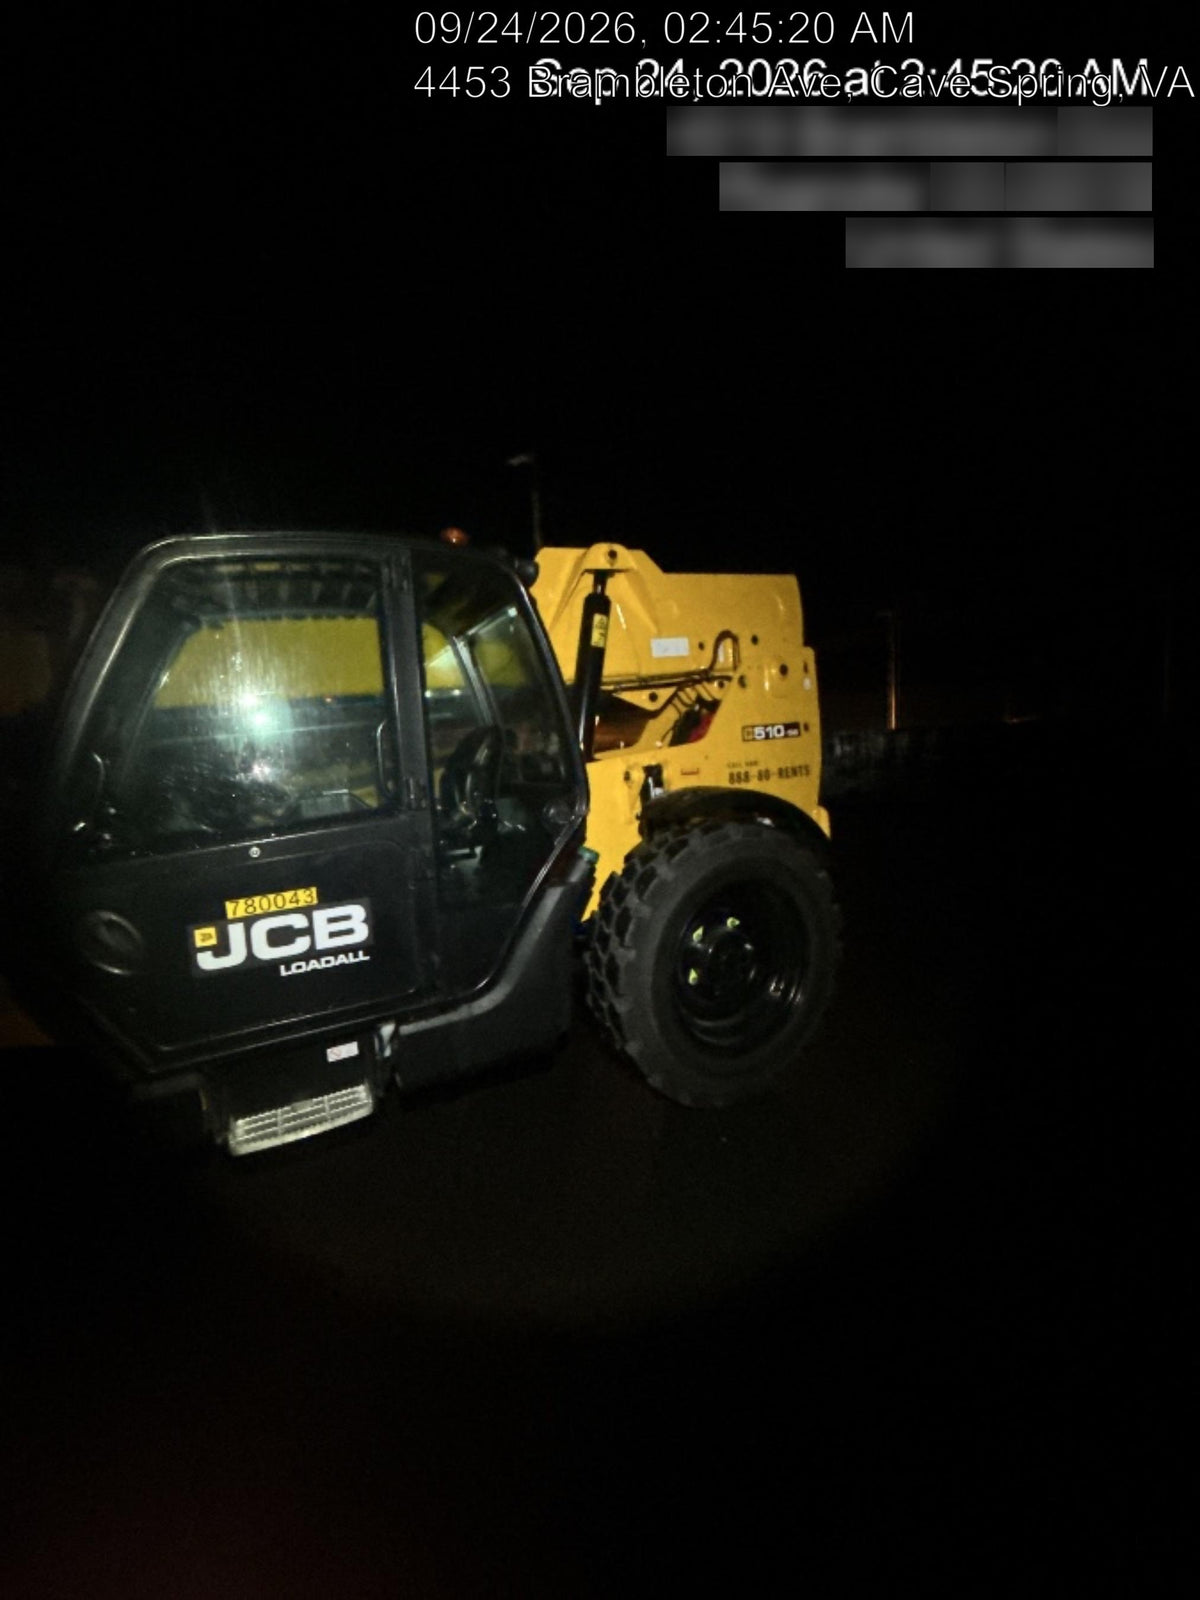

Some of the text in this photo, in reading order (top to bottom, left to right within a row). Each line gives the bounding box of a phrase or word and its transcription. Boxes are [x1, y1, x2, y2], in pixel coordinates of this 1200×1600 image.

[229, 888, 314, 917] 780043
[196, 904, 369, 971] JCB
[279, 950, 371, 977] LOADALL
